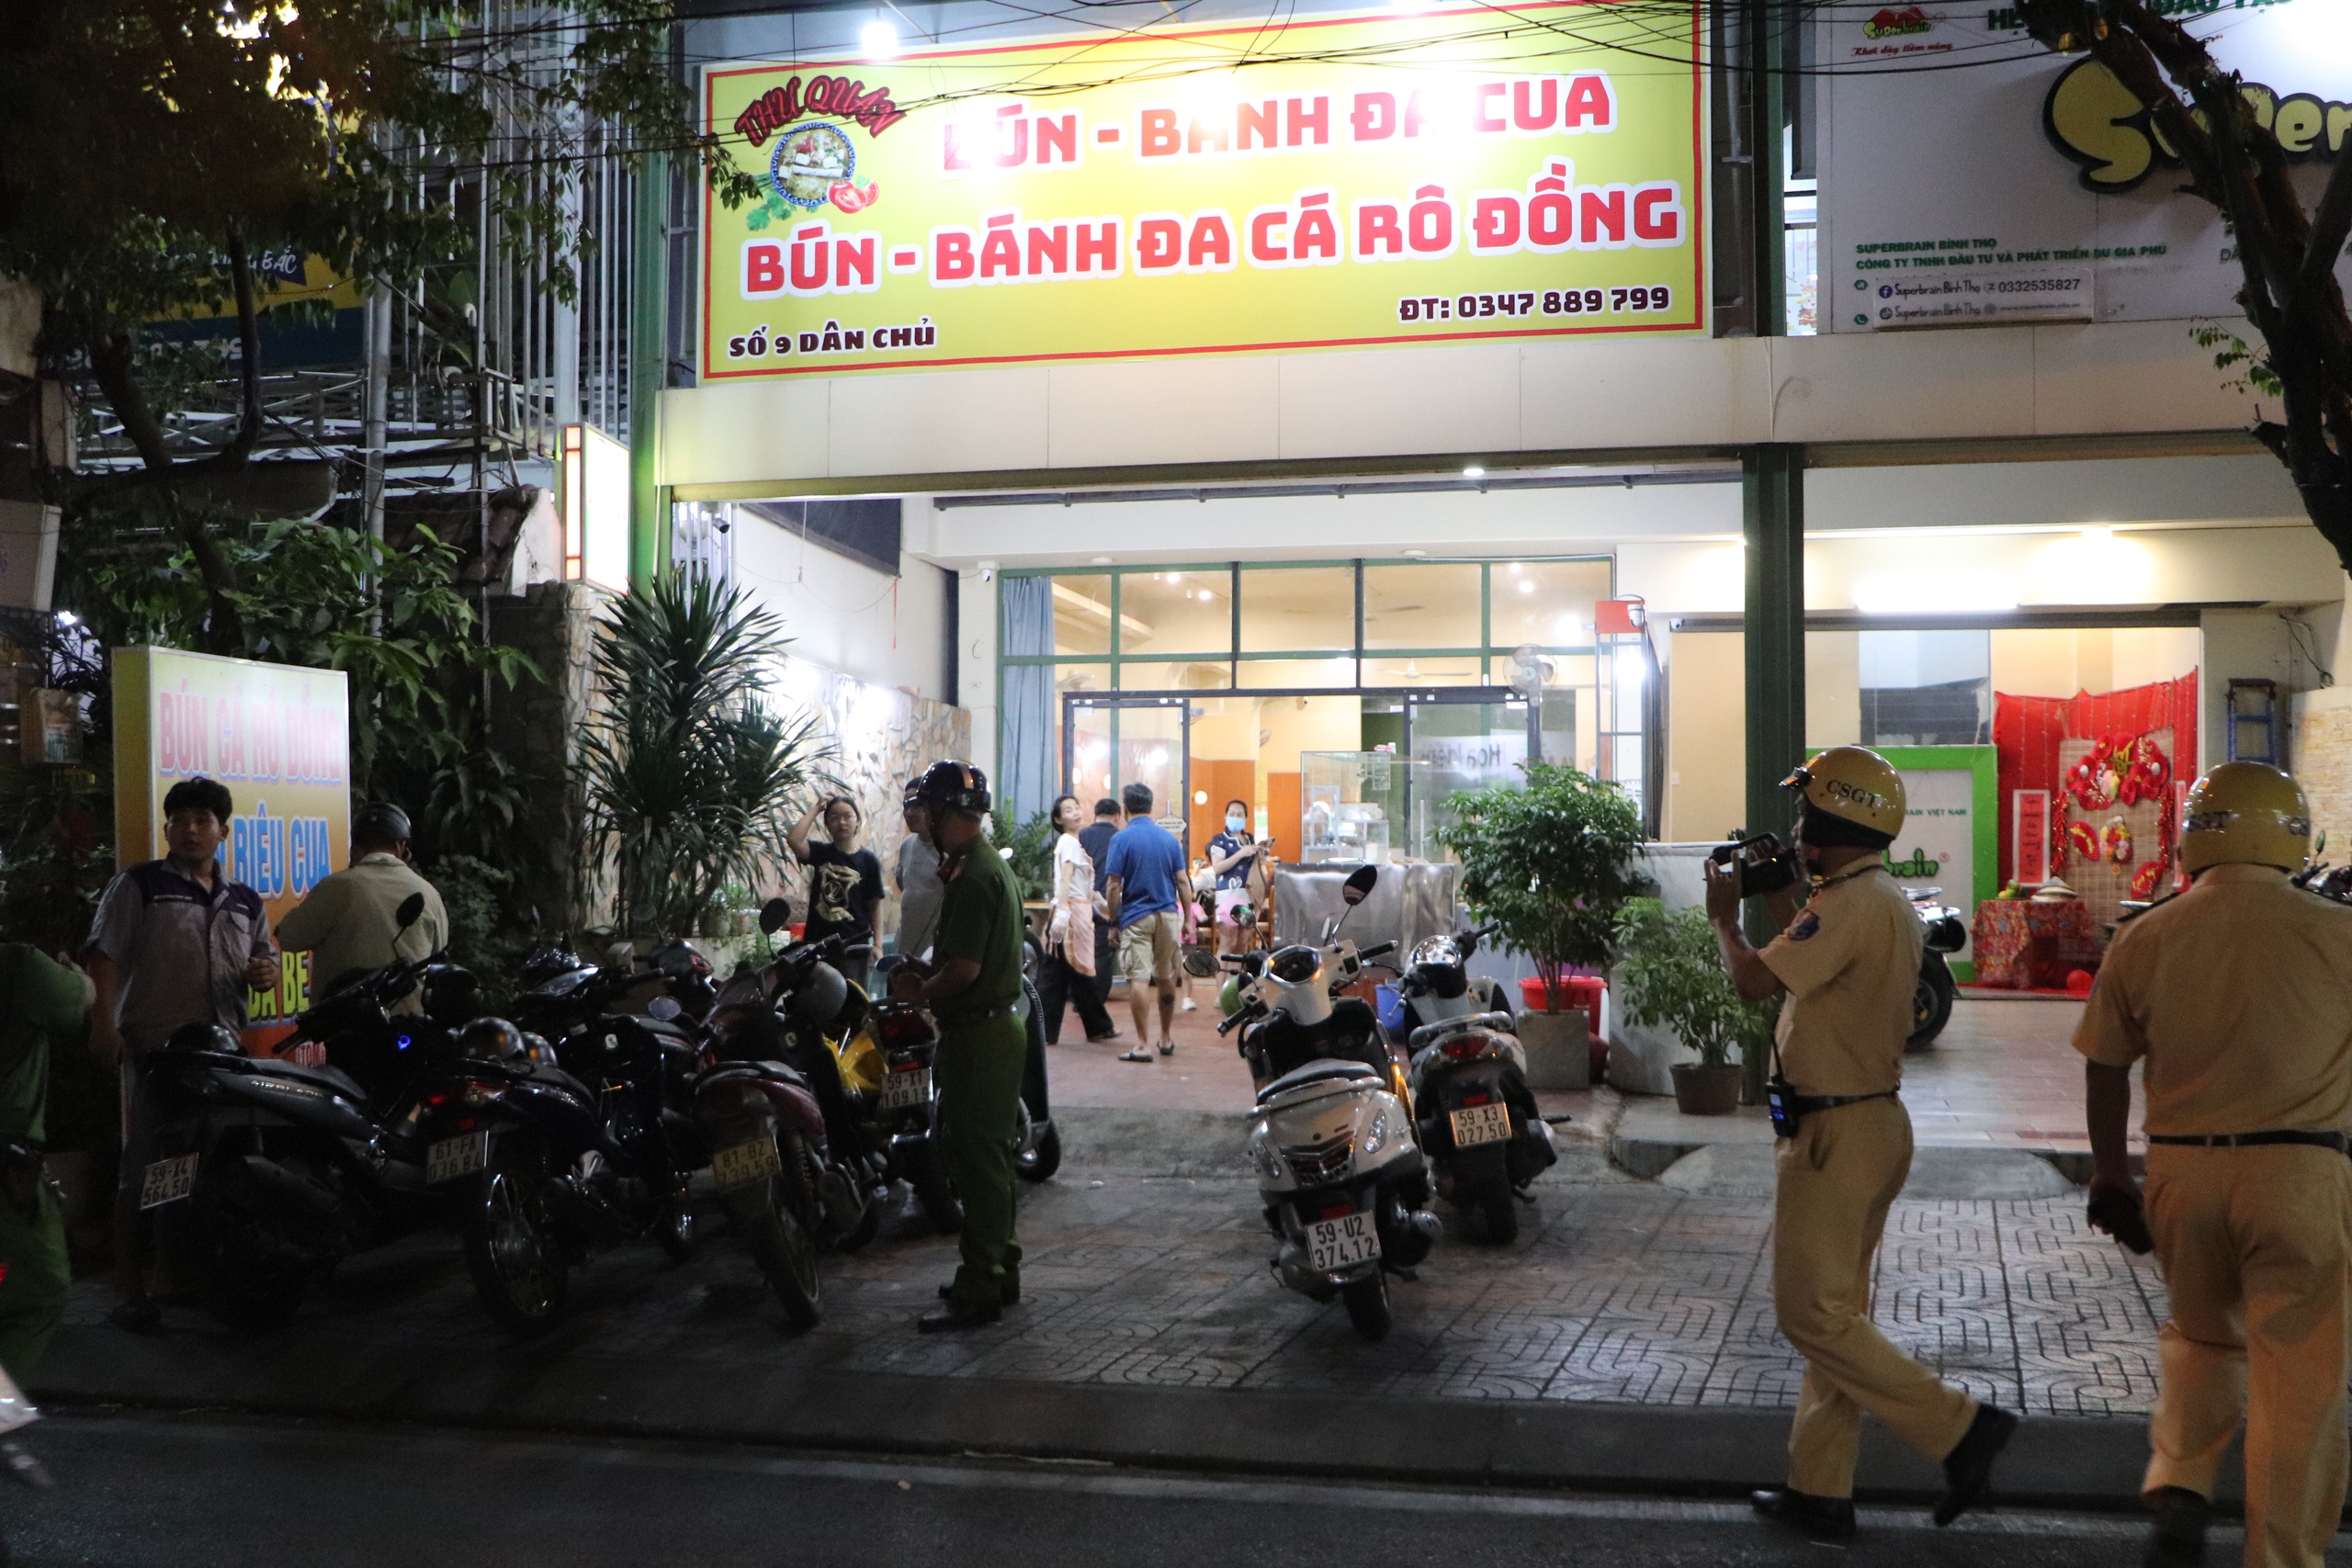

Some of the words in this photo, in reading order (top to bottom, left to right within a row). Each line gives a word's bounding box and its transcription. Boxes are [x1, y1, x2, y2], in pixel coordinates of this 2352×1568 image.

[1473, 75, 1611, 133] CUA
[747, 226, 875, 292] BÚN
[935, 213, 1117, 280] BÁNH
[1136, 215, 1230, 269] ĐA
[1250, 192, 1336, 261] CÁ
[1358, 184, 1452, 255] RÔ
[1472, 163, 1678, 249] ĐỒNG
[1856, 241, 1935, 254] SUPERBRAIN
[1939, 238, 1970, 250] BÌNH
[1972, 238, 1997, 251] THỌ
[1856, 258, 1891, 270] CÔNG
[1894, 258, 1908, 268] TY
[1912, 256, 1946, 266] TNHH
[2017, 249, 2050, 262] PHÁT
[2114, 246, 2136, 257] GIA
[1998, 278, 2081, 293] 0332535827
[1399, 296, 1450, 321] ĐT:
[1458, 292, 1534, 318] 0347
[1543, 289, 1603, 314] 889
[1611, 287, 1669, 310] 799
[729, 325, 767, 356] SỐ
[775, 339, 792, 354] 9
[799, 321, 865, 352] DÂN
[873, 318, 935, 347] CHỦ
[1826, 779, 1881, 809] CSGT
[1458, 1106, 1499, 1128] 59-X3
[1457, 1121, 1508, 1146] 027.50
[1315, 1215, 1365, 1246] 59-U2
[1314, 1236, 1376, 1269] 374.12
